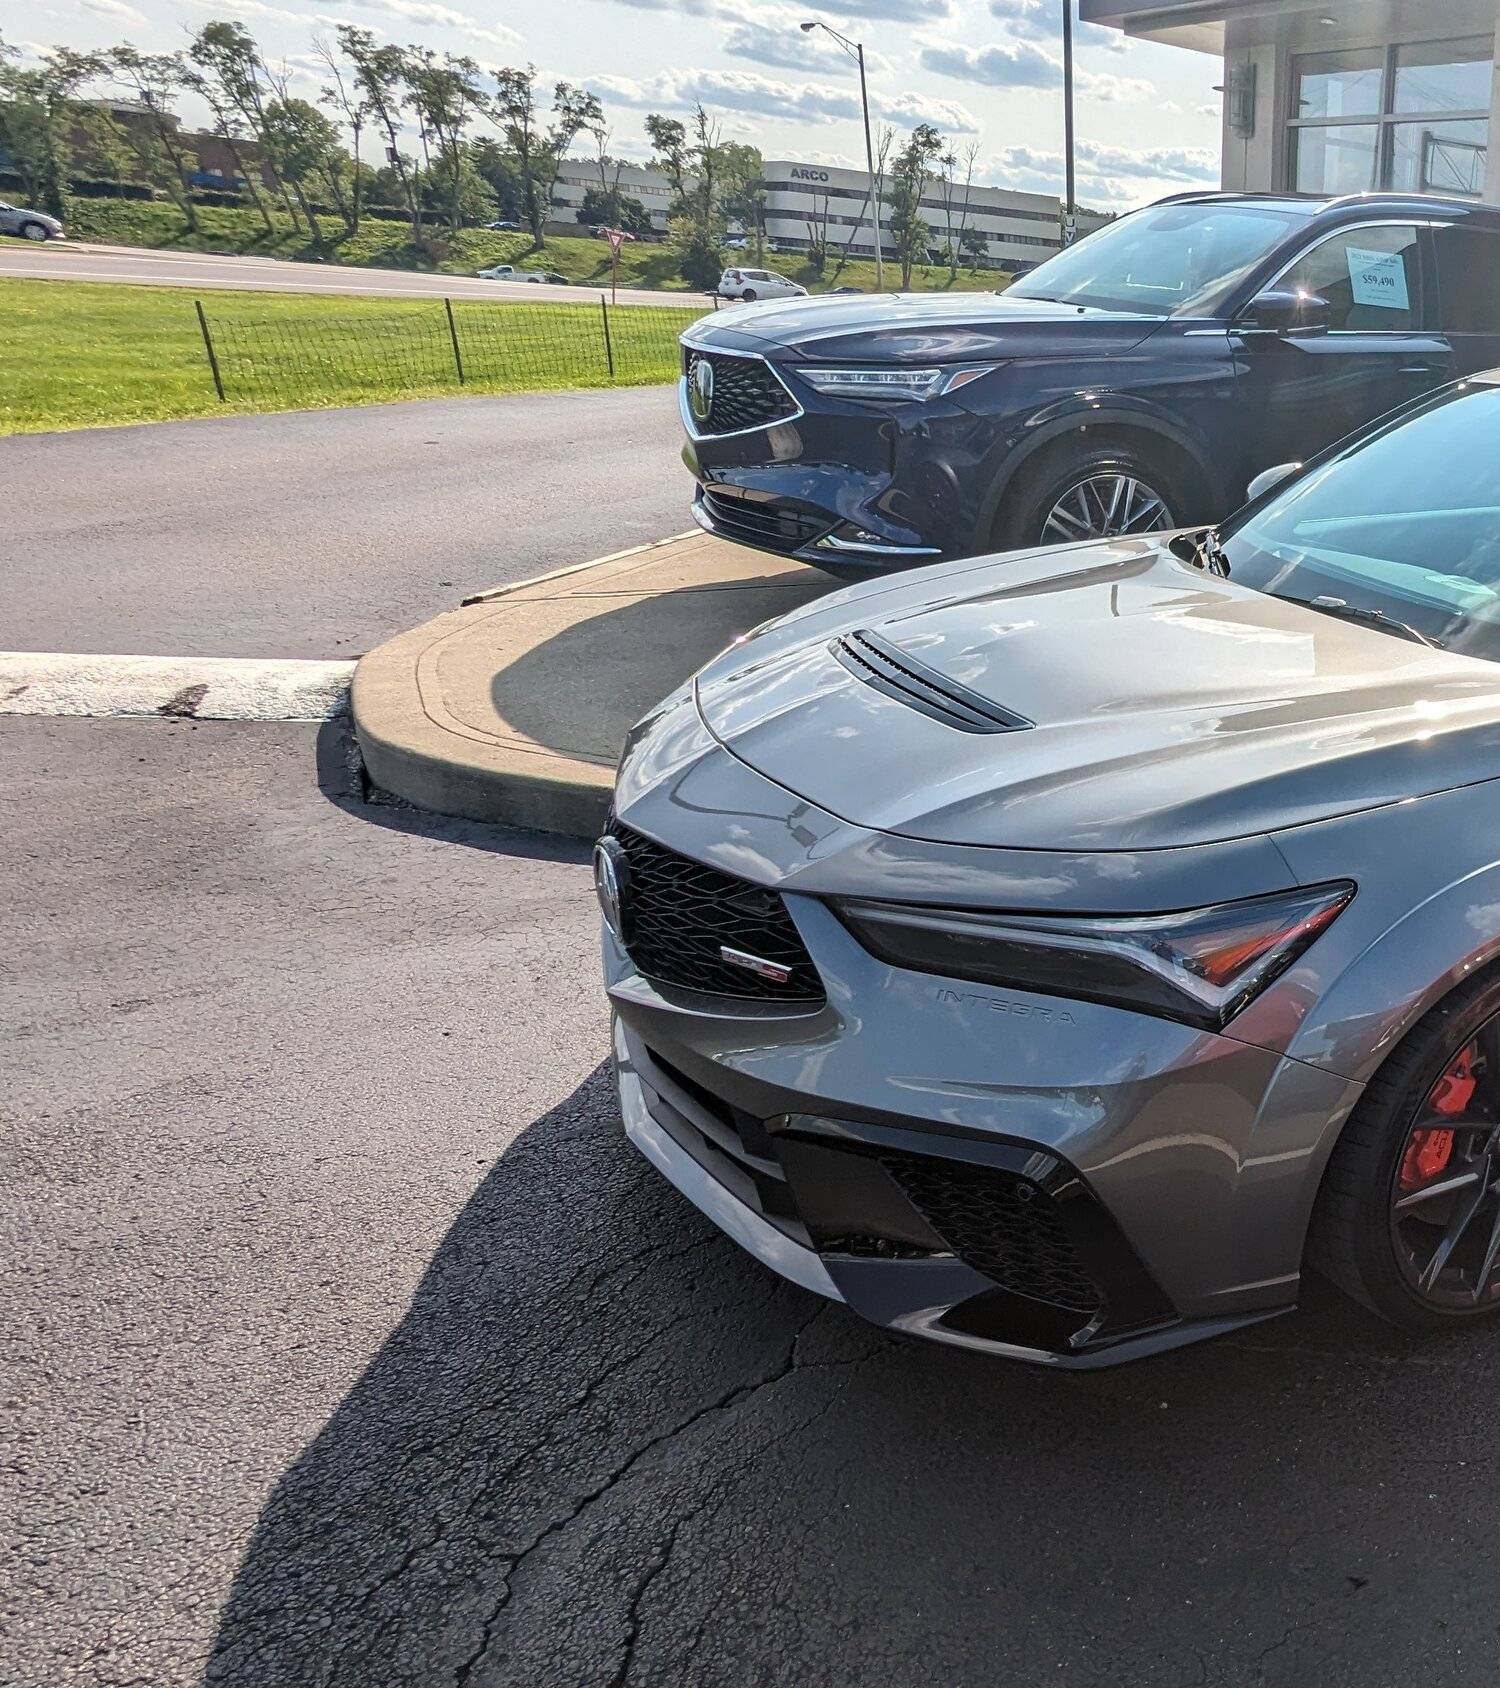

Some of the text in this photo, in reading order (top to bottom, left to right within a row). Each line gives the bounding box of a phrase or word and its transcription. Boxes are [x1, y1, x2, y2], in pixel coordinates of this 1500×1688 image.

[790, 167, 829, 182] ARCO
[1362, 273, 1395, 288] $59,490
[936, 989, 1077, 1026] INTEGRA
